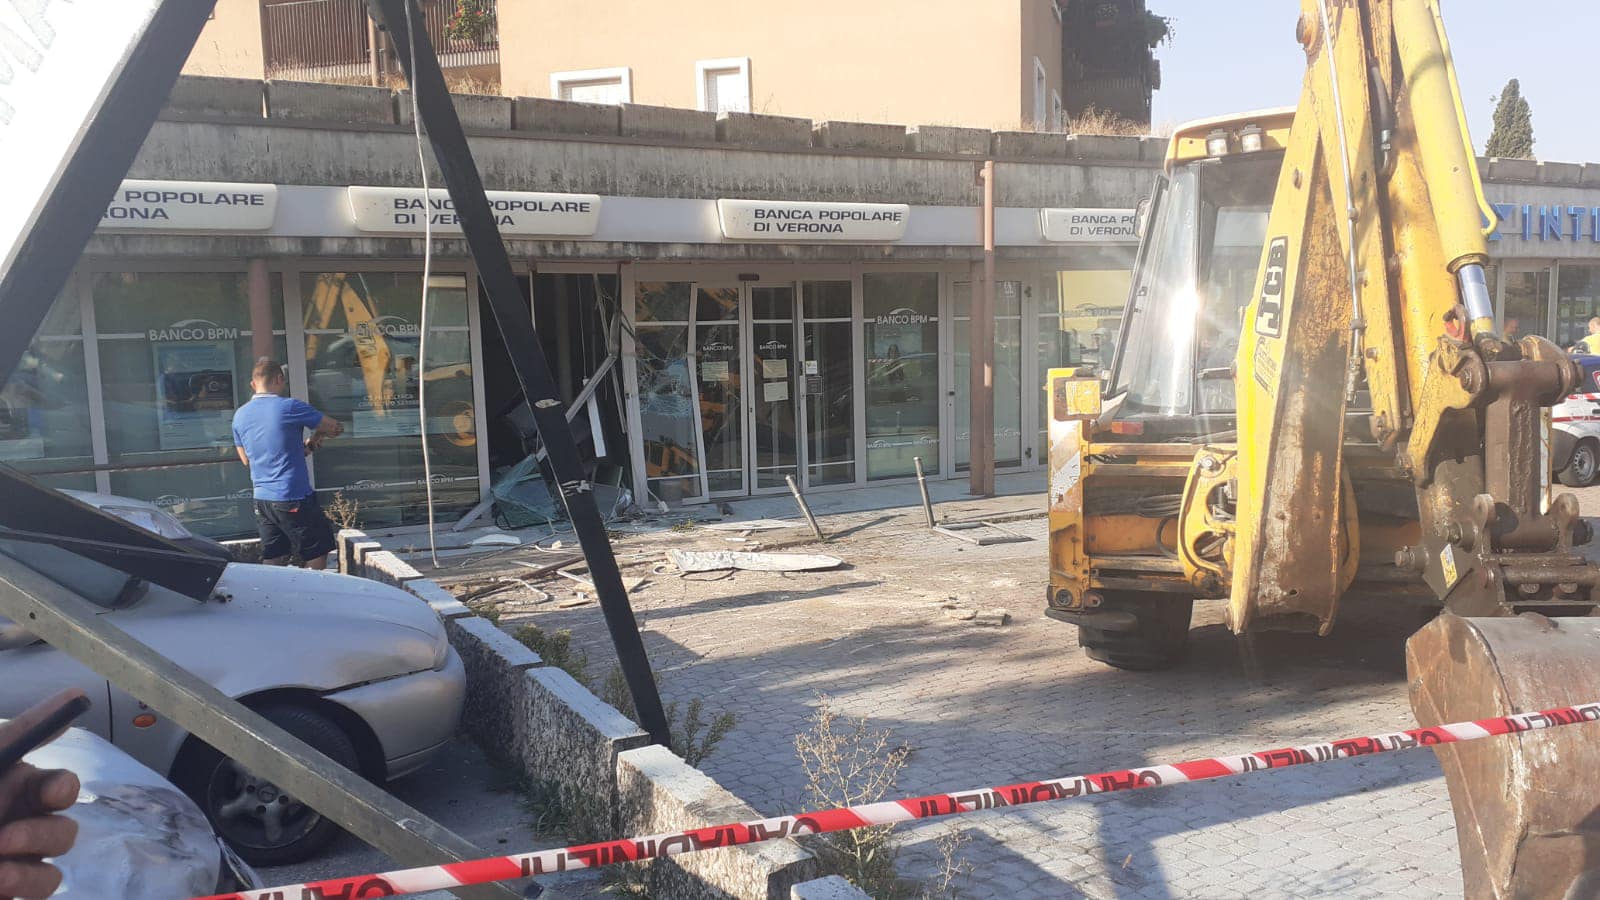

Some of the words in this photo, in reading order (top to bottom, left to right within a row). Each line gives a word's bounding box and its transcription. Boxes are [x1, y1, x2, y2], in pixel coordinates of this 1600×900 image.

[125, 191, 264, 206] POPOLARE
[394, 198, 456, 210] BANC
[103, 206, 169, 219] ONA
[754, 208, 813, 220] BANCA
[819, 210, 902, 222] POPOLARE
[394, 213, 415, 225] DI
[1071, 215, 1117, 224] BANCA
[753, 222, 770, 232] DI
[776, 222, 843, 233] VERONA
[1070, 226, 1083, 235] DI
[1259, 244, 1284, 329] JCB
[877, 314, 909, 325] BANCO
[910, 314, 928, 324] BPM
[149, 328, 204, 341] BANCO
[207, 328, 238, 340] BPM
